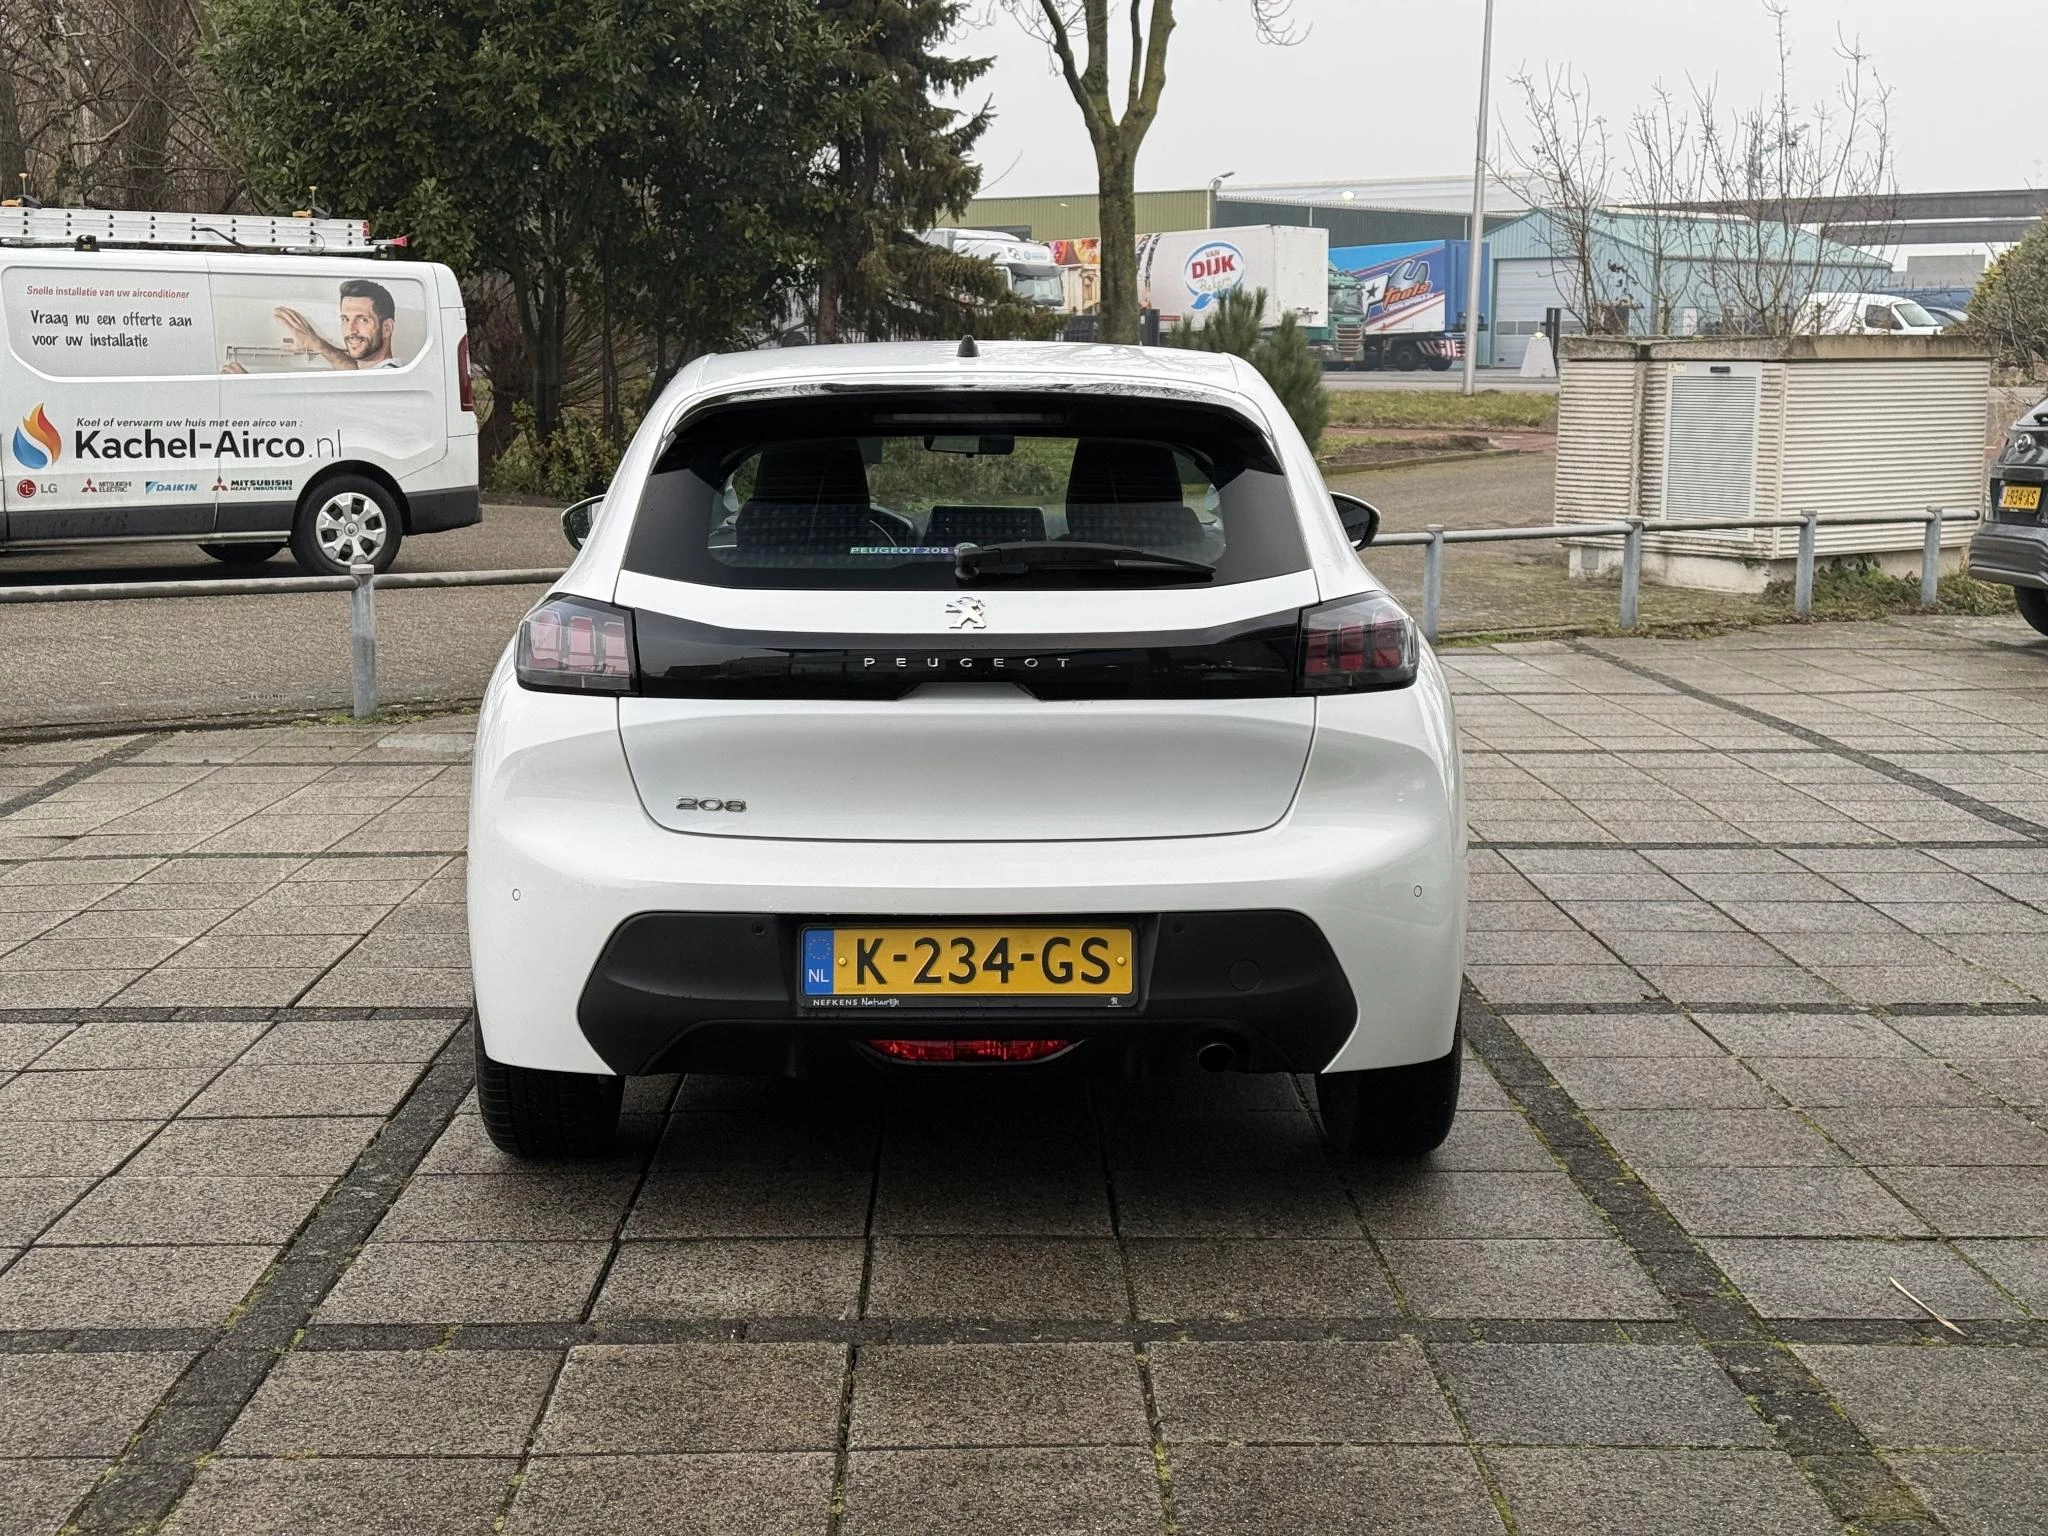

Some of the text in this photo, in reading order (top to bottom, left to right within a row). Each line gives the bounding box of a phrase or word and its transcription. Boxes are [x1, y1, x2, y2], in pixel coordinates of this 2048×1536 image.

[1205, 249, 1220, 257] VAN
[1191, 254, 1236, 279] DIJK
[26, 286, 53, 296] Snelle
[55, 286, 97, 297] installatie
[99, 289, 114, 297] van
[132, 289, 189, 299] airconditioner
[31, 310, 193, 327] Vraag nu een offerte aan
[32, 333, 149, 347] voor uw installatie
[76, 418, 101, 427] Koel
[103, 418, 115, 427] of
[185, 418, 206, 427] huis
[252, 419, 277, 427] airco
[75, 428, 342, 459] Kachel-Airco.nl
[40, 483, 58, 493] LG
[156, 484, 198, 492] DAIKIN
[850, 546, 919, 554] PEUGEOT
[864, 657, 1070, 669] PEUGEOT
[676, 798, 747, 813] 208
[856, 936, 1111, 984] K-234-GS
[808, 969, 829, 983] NL
